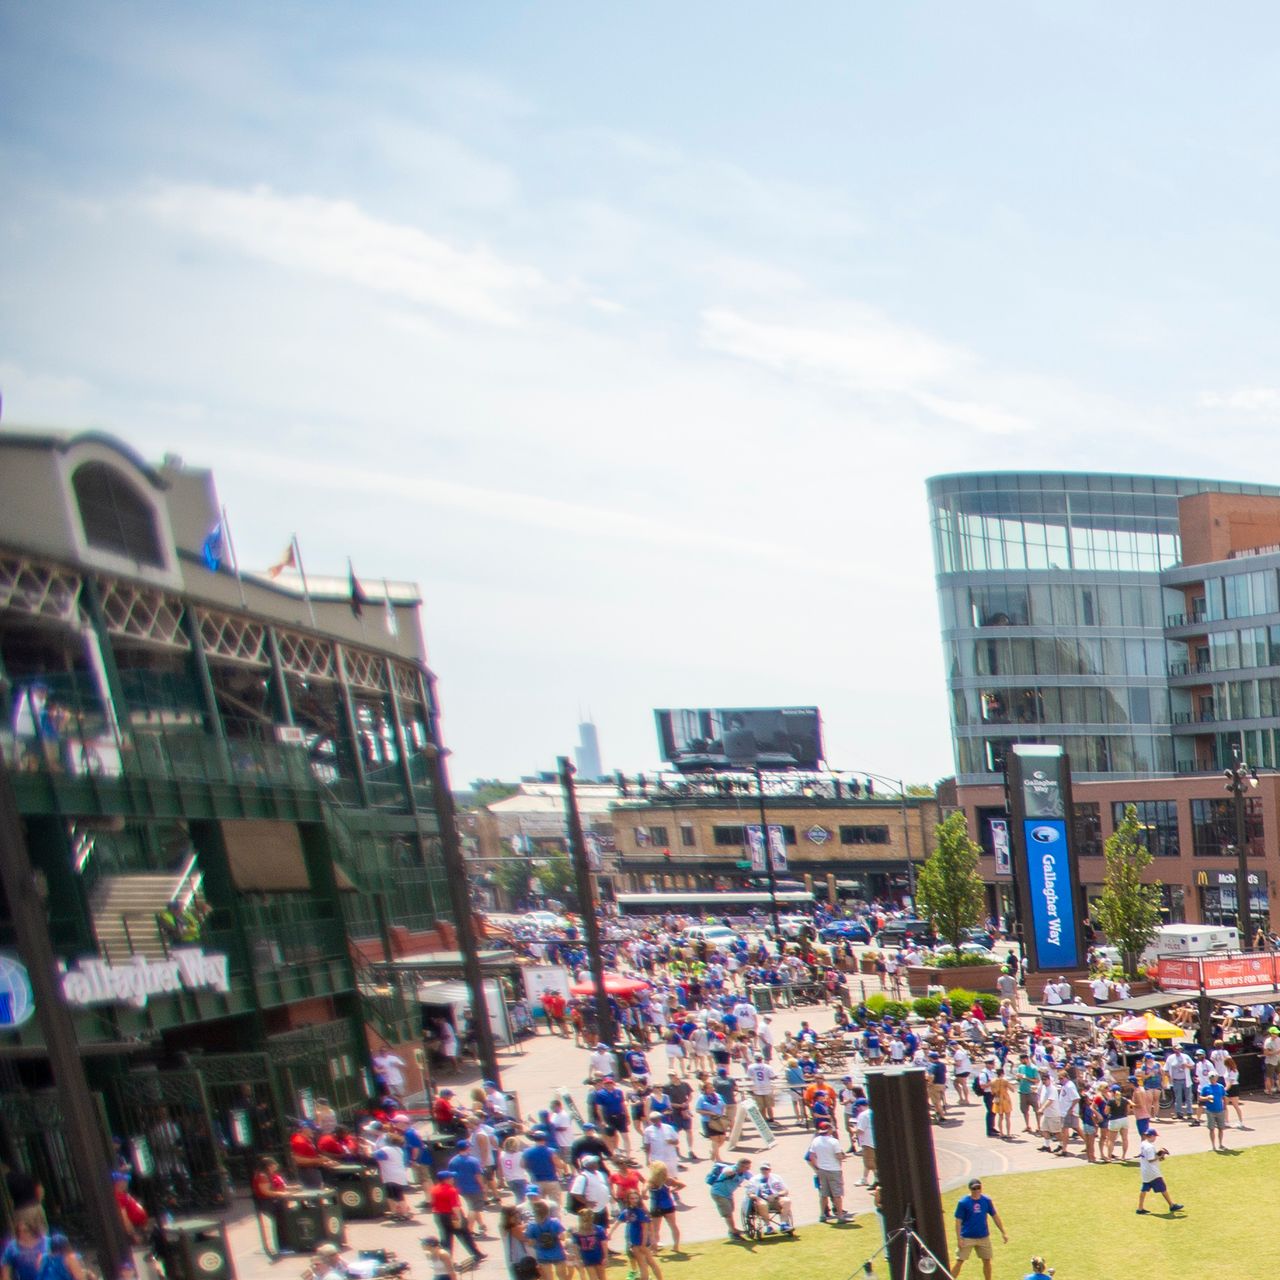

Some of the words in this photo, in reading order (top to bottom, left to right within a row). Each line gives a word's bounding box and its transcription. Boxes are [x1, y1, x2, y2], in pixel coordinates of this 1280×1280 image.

[1024, 778, 1057, 789] Gallagher
[1033, 785, 1050, 793] Way
[1041, 853, 1058, 918] Gallagher
[1047, 917, 1062, 946] Way
[172, 948, 229, 992] Way
[1208, 977, 1224, 987] THIS
